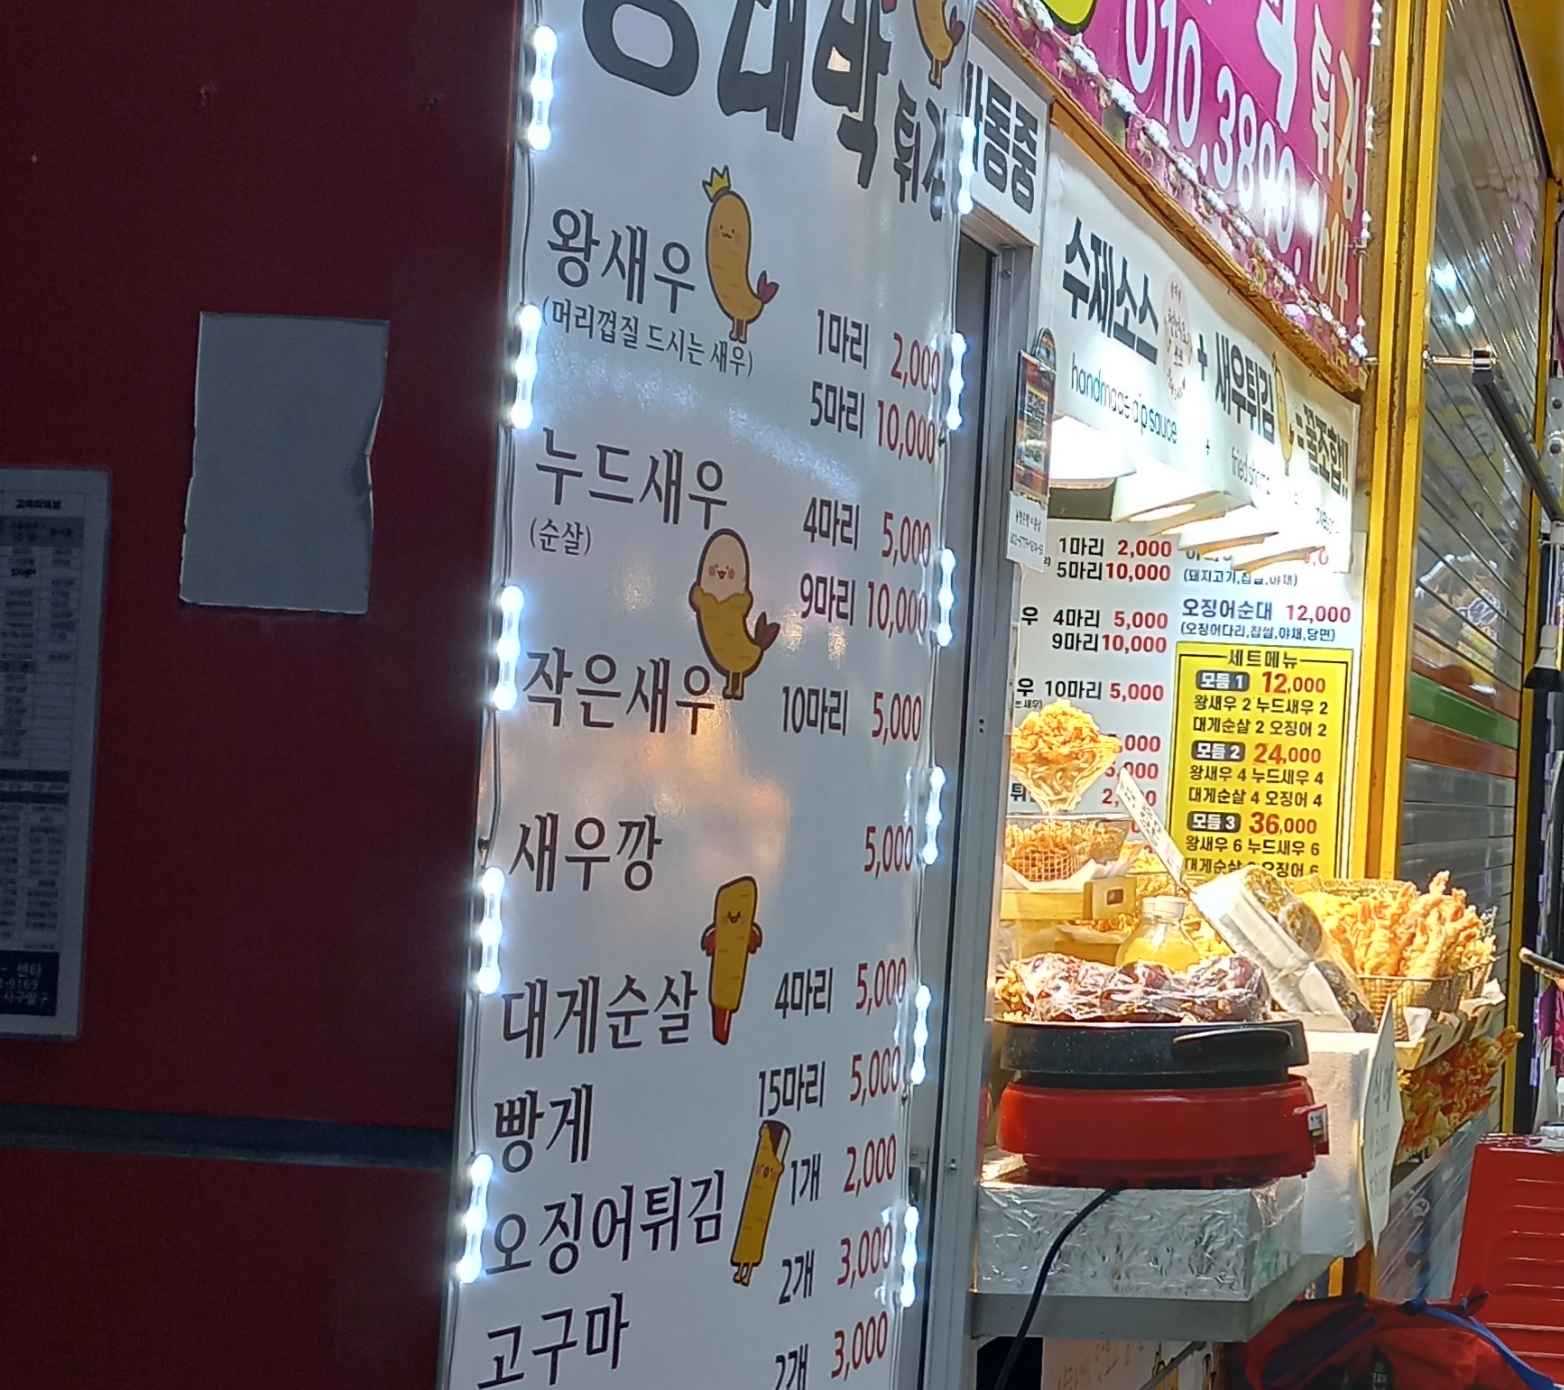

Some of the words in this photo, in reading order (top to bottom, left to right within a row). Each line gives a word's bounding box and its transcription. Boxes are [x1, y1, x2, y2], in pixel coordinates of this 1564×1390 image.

[547, 208, 696, 313] 왕새우
[541, 294, 641, 352] (머리껍질
[645, 326, 704, 366] 드시는
[709, 339, 753, 378] 새우)
[817, 309, 869, 369] 1마리
[891, 332, 940, 395] 2,000
[1063, 216, 1159, 366] 수제소스
[1215, 331, 1275, 445] 새우튀김
[1304, 403, 1349, 500] 꿀조합!!
[810, 381, 864, 439] 5마리
[877, 399, 936, 465] 10,000
[535, 427, 727, 530] 누드새우
[529, 516, 592, 557] (순살)
[803, 497, 860, 551] 4마리
[882, 512, 931, 569] 5,000
[1059, 537, 1104, 557] 1마리
[1117, 539, 1172, 558] 2,000
[1056, 561, 1102, 581] 5마리
[1106, 562, 1171, 582] 10,000
[800, 573, 856, 627] 9마리
[867, 581, 928, 638] 10,000
[1053, 609, 1100, 628] 4마리
[1114, 610, 1169, 630] 5,000
[1182, 598, 1273, 621] 오징어순대
[1286, 604, 1351, 625] 12,000
[1052, 632, 1098, 652] 9마리
[1102, 634, 1167, 654] 10,000
[1228, 649, 1298, 670] 세트메뉴
[523, 647, 715, 736] 작은새우
[781, 685, 847, 737] 10마리
[871, 693, 922, 742] 5,000
[1045, 680, 1102, 700] 10마리
[1110, 682, 1164, 702] 5,000
[1236, 674, 1244, 689] 1
[1261, 671, 1326, 695] 12,000
[1194, 694, 1237, 711] 왕새우
[1242, 698, 1251, 711] 2
[1256, 697, 1314, 715] 누드새우
[1319, 701, 1329, 715] 2
[1193, 716, 1251, 735] 대게순살
[1255, 721, 1265, 734] 2
[1269, 720, 1312, 737] 오징어
[1317, 723, 1327, 737] 2
[1230, 744, 1240, 759] 2
[1253, 742, 1321, 765] 24,000
[1189, 765, 1232, 782] 왕새우
[1237, 768, 1247, 782] 4
[1251, 767, 1310, 786] 누드새우
[1314, 771, 1324, 785] 4
[1188, 787, 1247, 805] 대게순살
[1250, 791, 1260, 804] 4
[1265, 790, 1308, 808] 오징어
[1313, 794, 1322, 807] 4
[1225, 815, 1236, 830] 3
[1249, 811, 1317, 835] 36,000
[509, 811, 662, 892] 새우깡
[864, 824, 914, 873] 5,000
[1185, 835, 1228, 853] 왕새우
[1233, 838, 1243, 852] 6
[1248, 838, 1305, 856] 누드새우
[1310, 842, 1320, 856] 6
[502, 970, 698, 1059] 대게순살
[775, 967, 834, 1019] 4마리
[856, 958, 907, 1012] 5,000
[495, 1083, 593, 1174] 빵게
[758, 1061, 826, 1117] 15마리
[850, 1047, 901, 1103] 5,000
[486, 1169, 725, 1275] 오징어튀김
[790, 1153, 822, 1205] 1개
[843, 1133, 896, 1197] 2,000
[477, 1293, 630, 1390] 고구마
[779, 1249, 814, 1304] 2개
[837, 1222, 894, 1288] 3,000
[831, 1310, 888, 1379] 3,000
